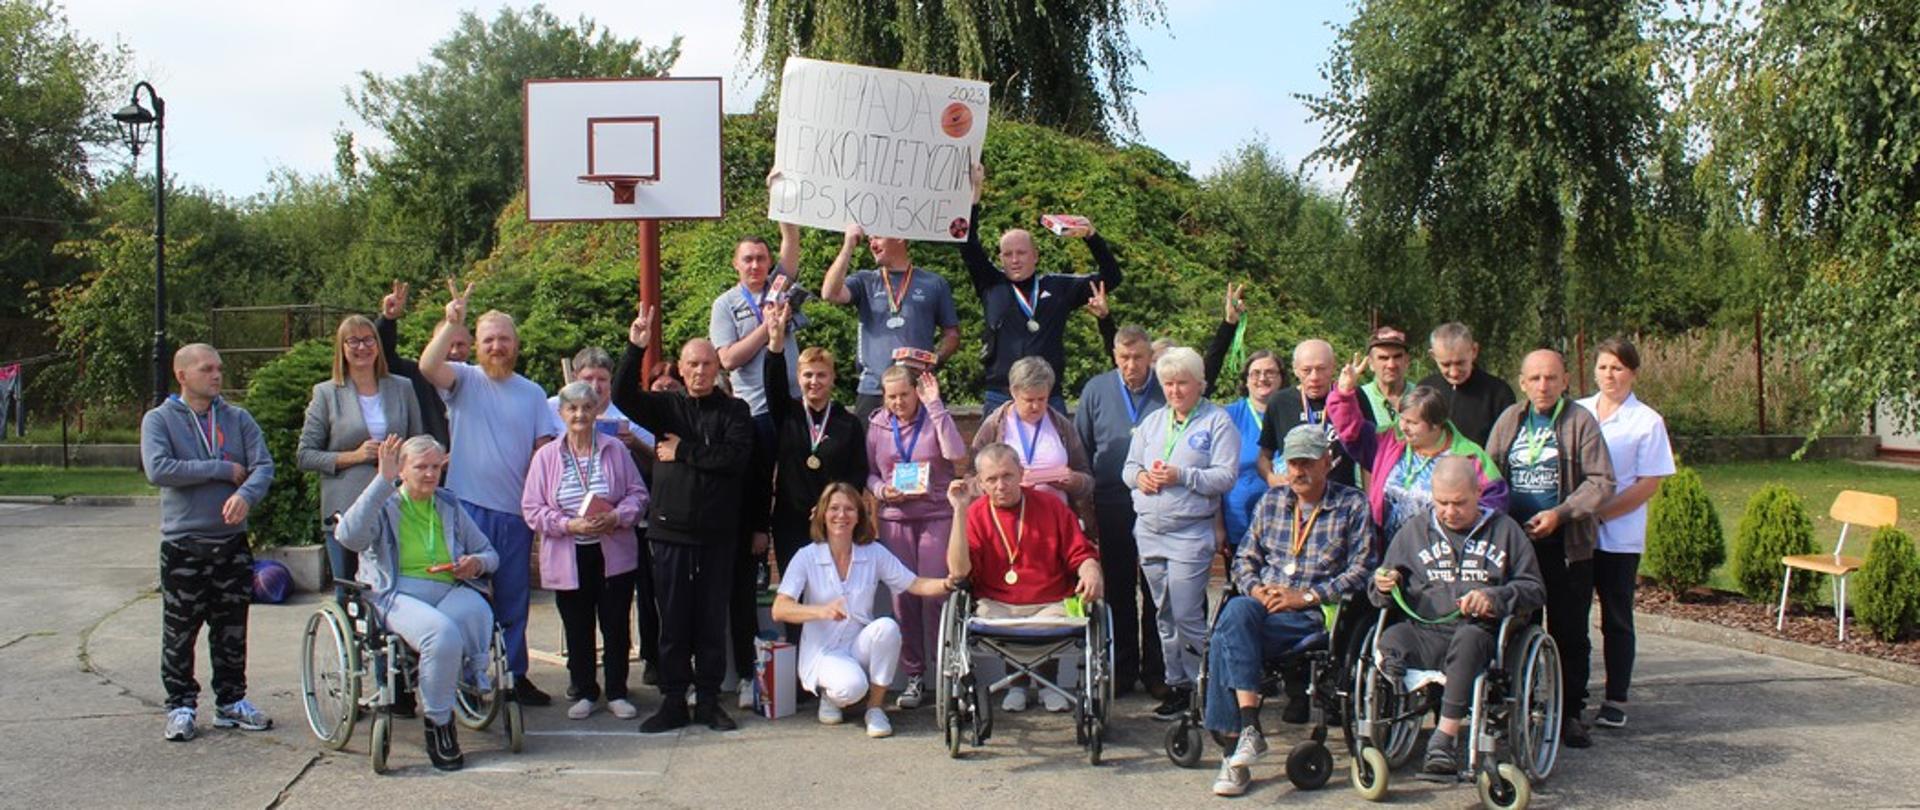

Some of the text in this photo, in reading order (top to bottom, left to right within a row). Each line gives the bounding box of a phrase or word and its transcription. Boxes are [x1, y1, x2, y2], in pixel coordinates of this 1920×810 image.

[784, 68, 936, 137] OLIMPIADA
[948, 86, 987, 105] 2023
[784, 123, 974, 193] LEKKOATLETYCZNA
[777, 177, 837, 220] DPS
